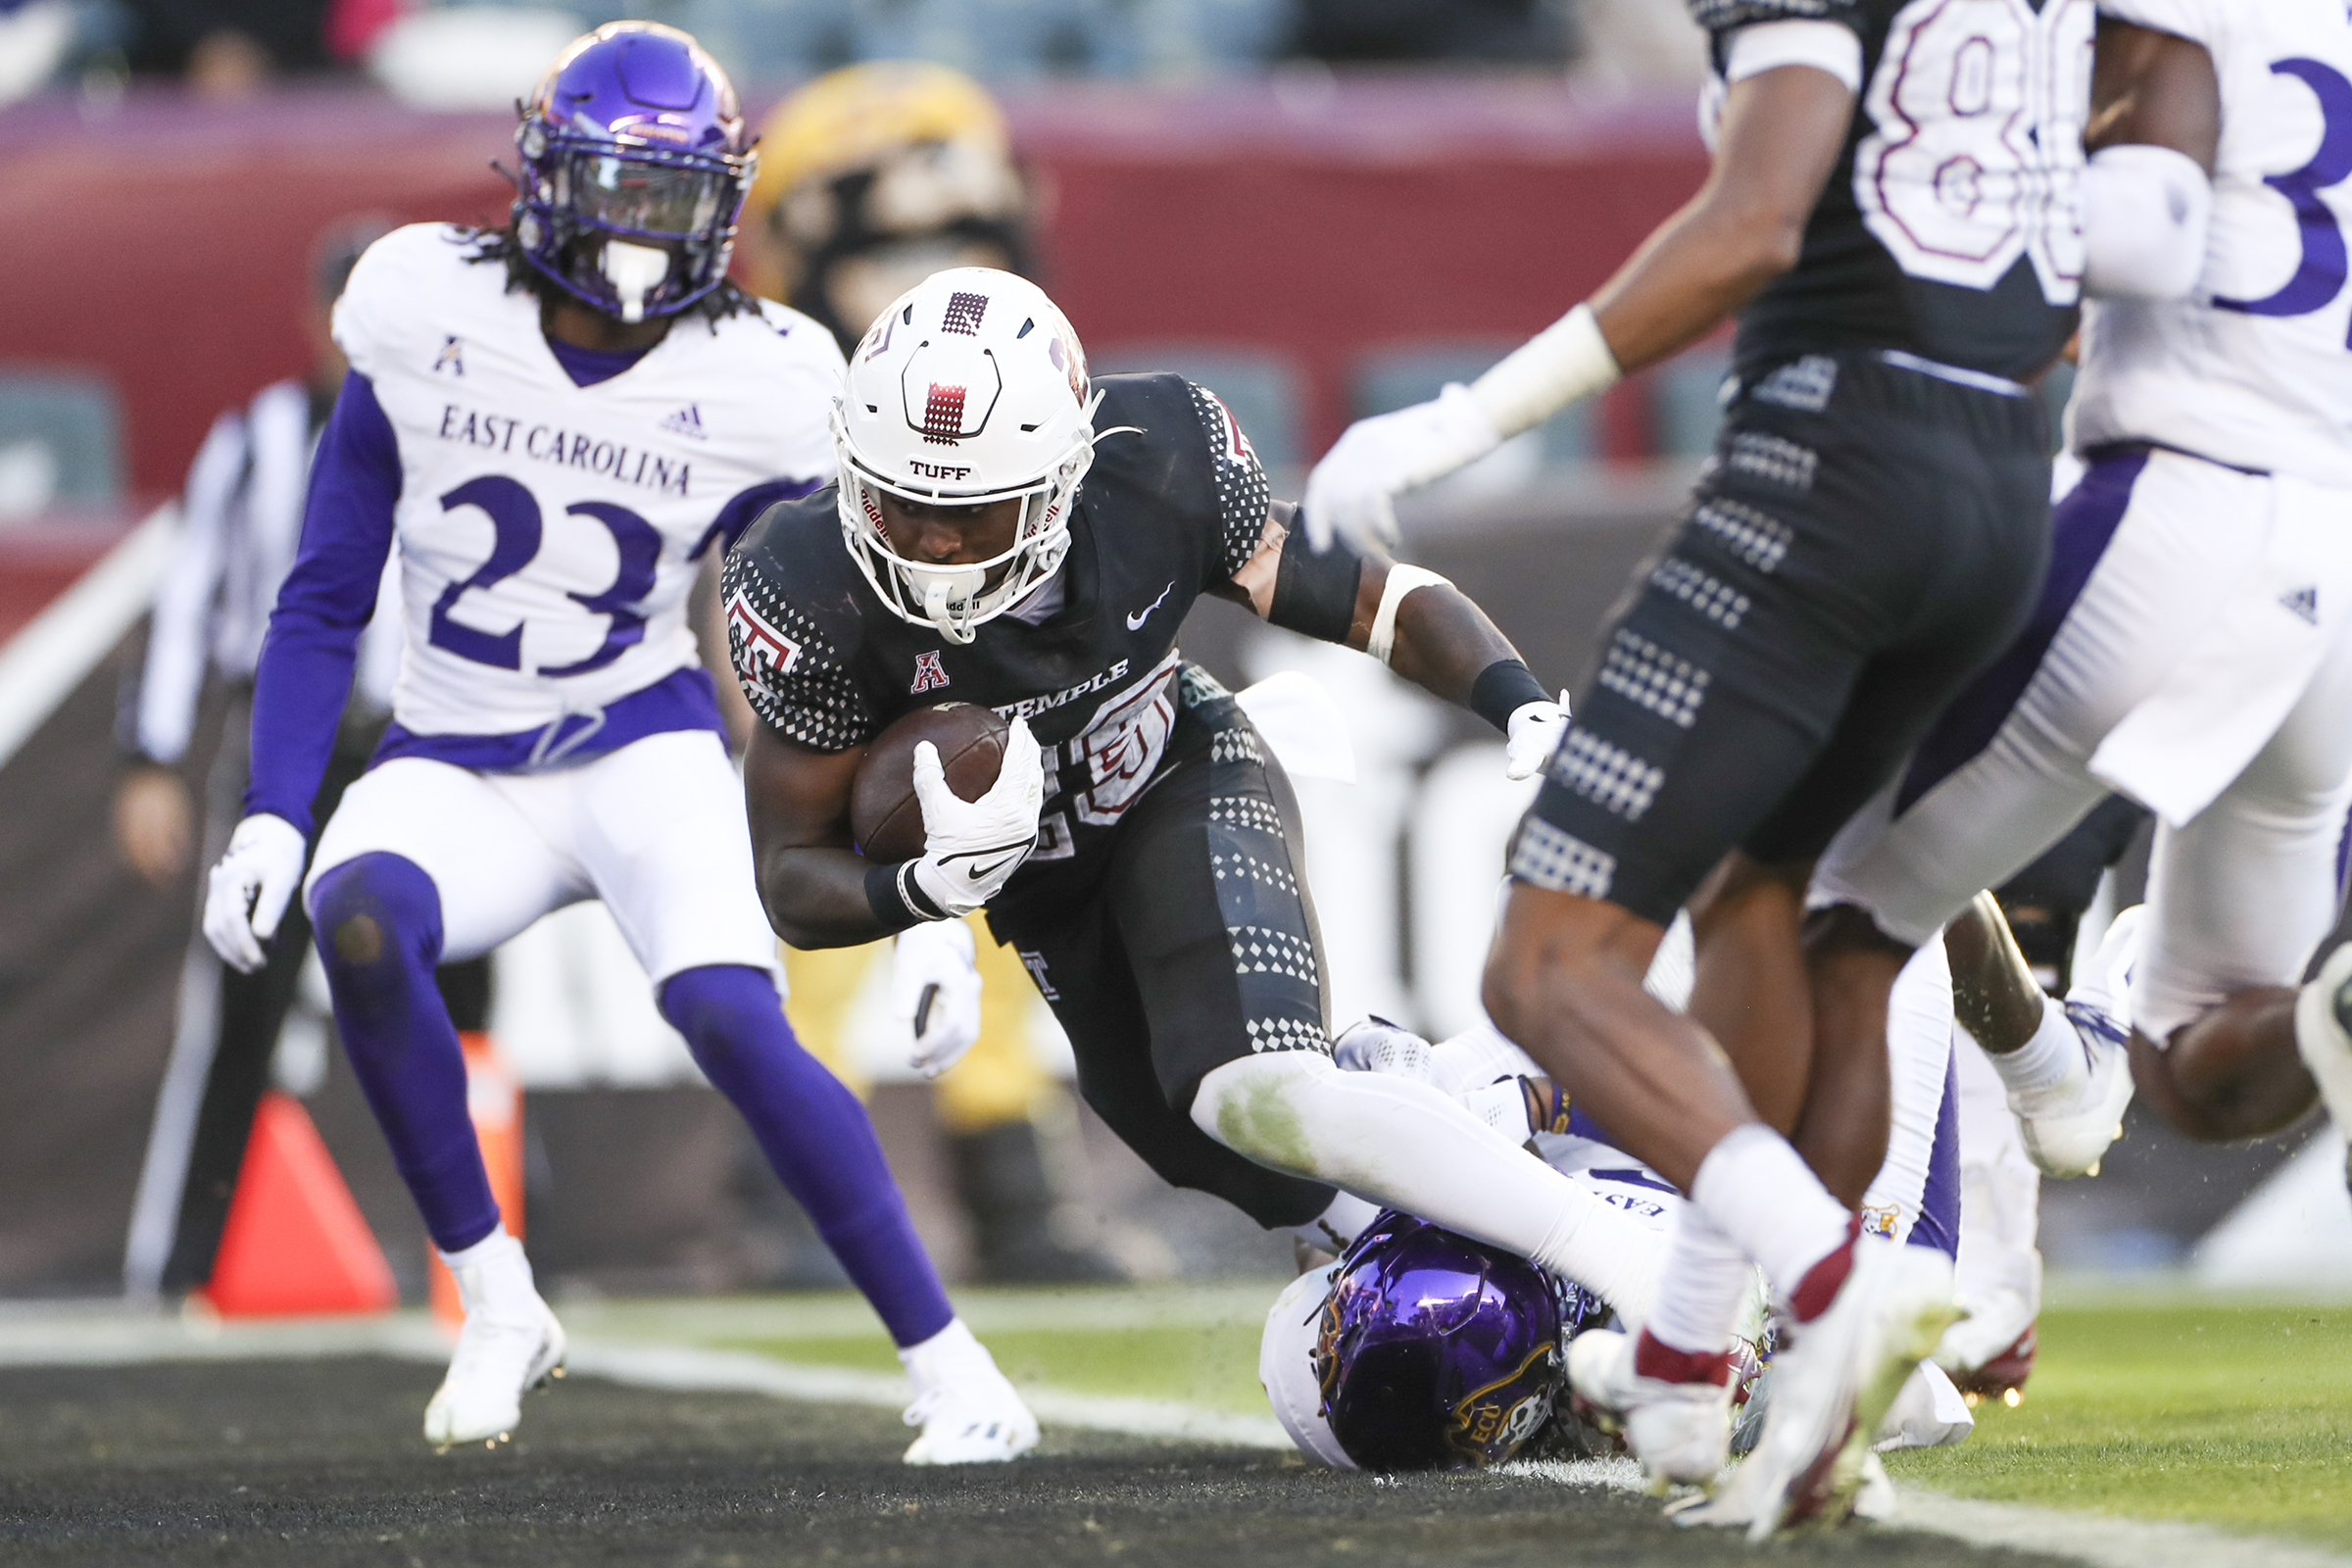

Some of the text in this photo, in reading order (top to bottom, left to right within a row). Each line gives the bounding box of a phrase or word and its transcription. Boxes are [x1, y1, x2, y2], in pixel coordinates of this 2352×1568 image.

[440, 404, 691, 497] EAST CAROLINA
[909, 460, 971, 481] TUFF
[428, 474, 662, 678] 23
[910, 649, 950, 695] A
[991, 658, 1129, 724] TEMPLE
[1471, 1402, 1501, 1444] ECU
